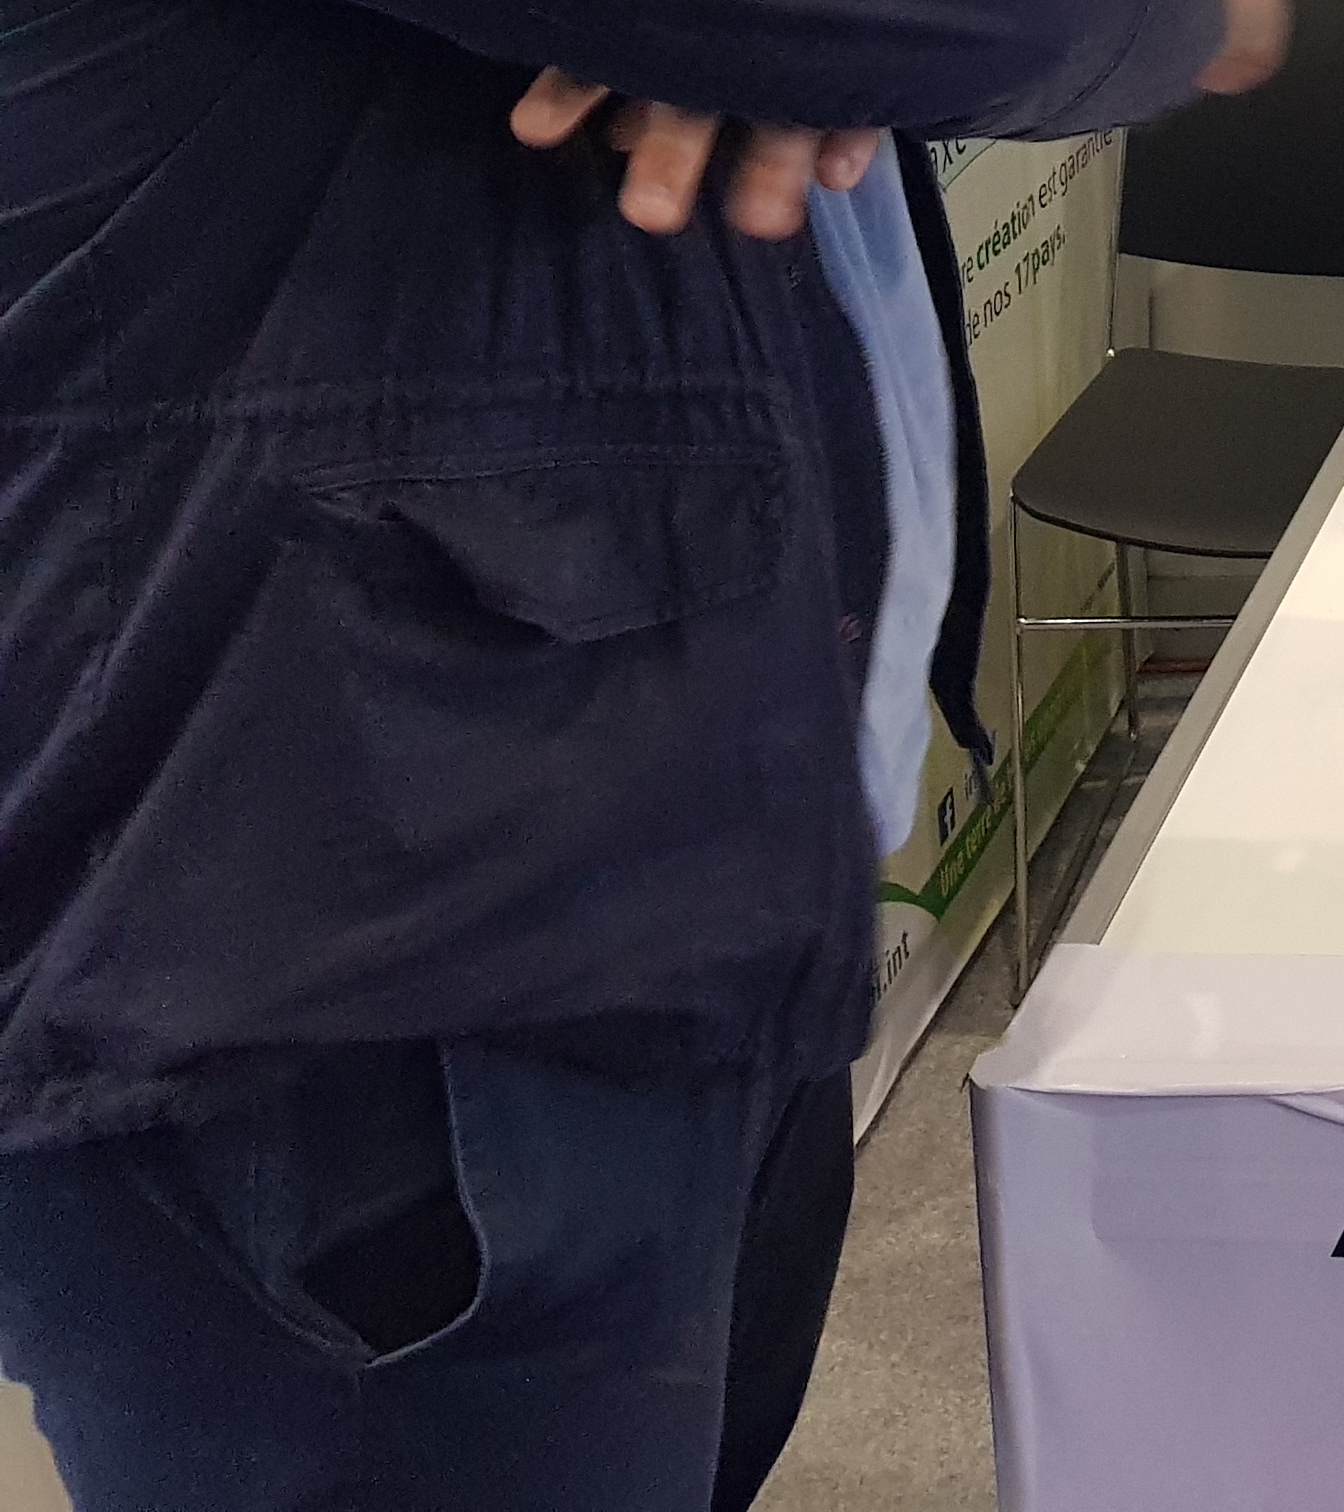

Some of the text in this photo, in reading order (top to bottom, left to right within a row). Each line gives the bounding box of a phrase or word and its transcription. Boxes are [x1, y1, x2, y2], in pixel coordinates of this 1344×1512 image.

[977, 169, 1057, 271] création est
[983, 284, 1012, 329] nos
[1015, 249, 1031, 295] 17
